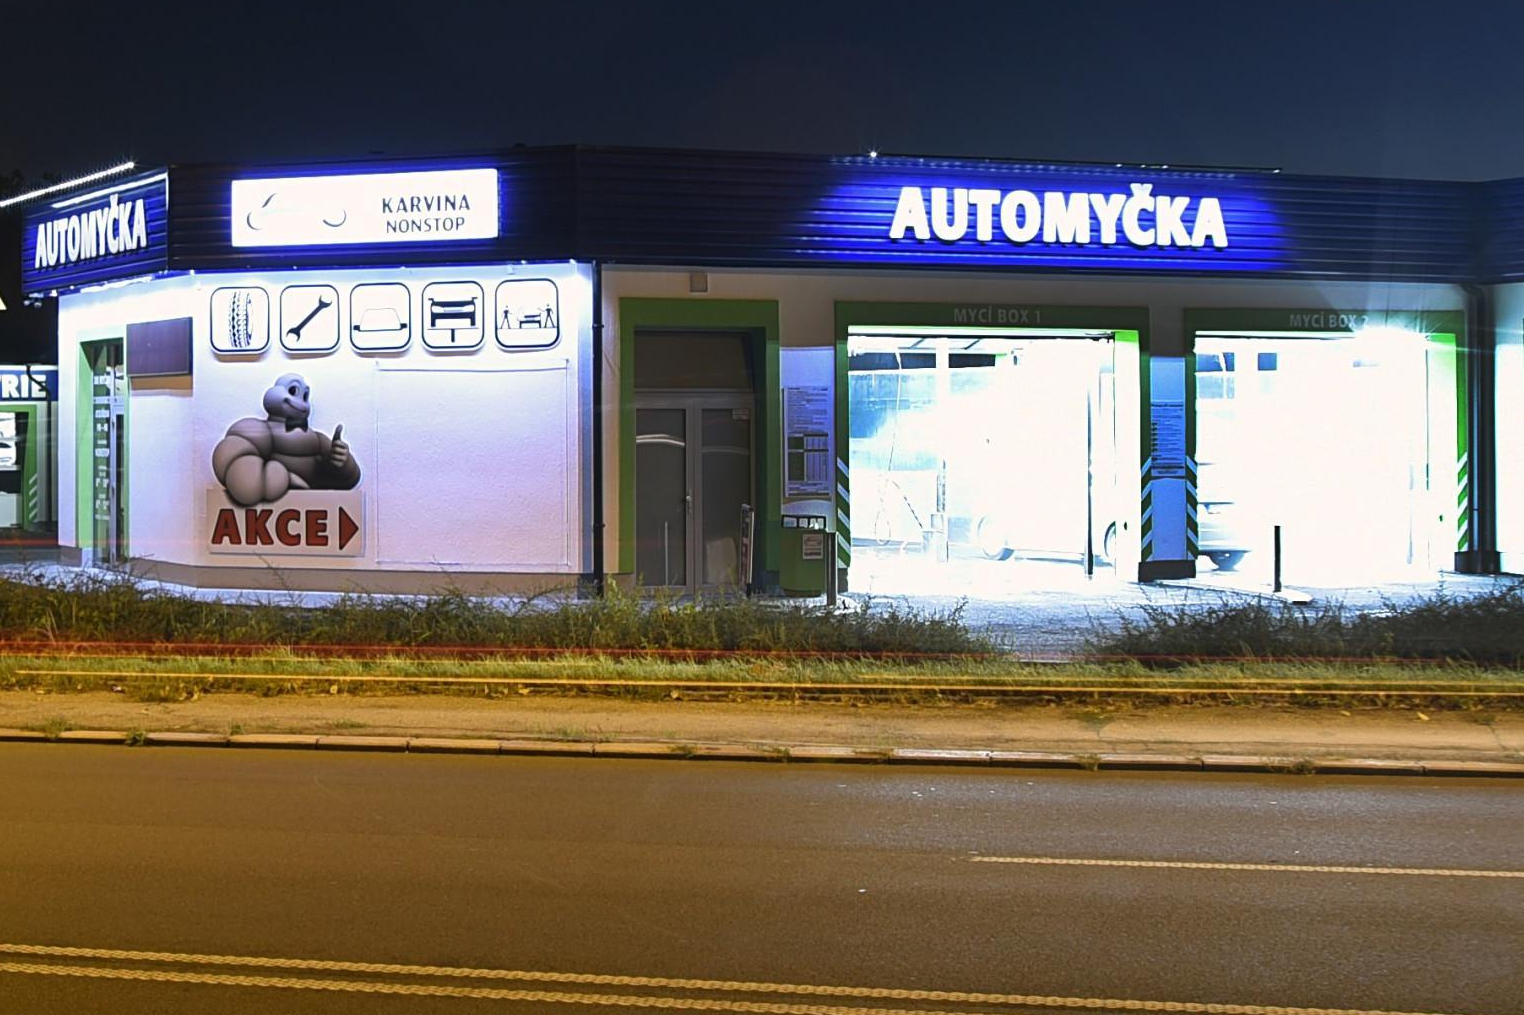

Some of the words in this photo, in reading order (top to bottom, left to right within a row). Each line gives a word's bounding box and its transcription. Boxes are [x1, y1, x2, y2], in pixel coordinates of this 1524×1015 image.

[382, 193, 471, 214] KARVINA
[386, 217, 465, 234] NONSTOP
[889, 182, 1229, 248] AUTOMYČKA
[34, 193, 147, 269] AUTOMYČKA
[953, 305, 992, 324] MYCÍ
[997, 308, 1029, 324] BOX
[1034, 309, 1042, 324] 1
[1328, 313, 1358, 329] BOX
[211, 508, 329, 547] AKCE
